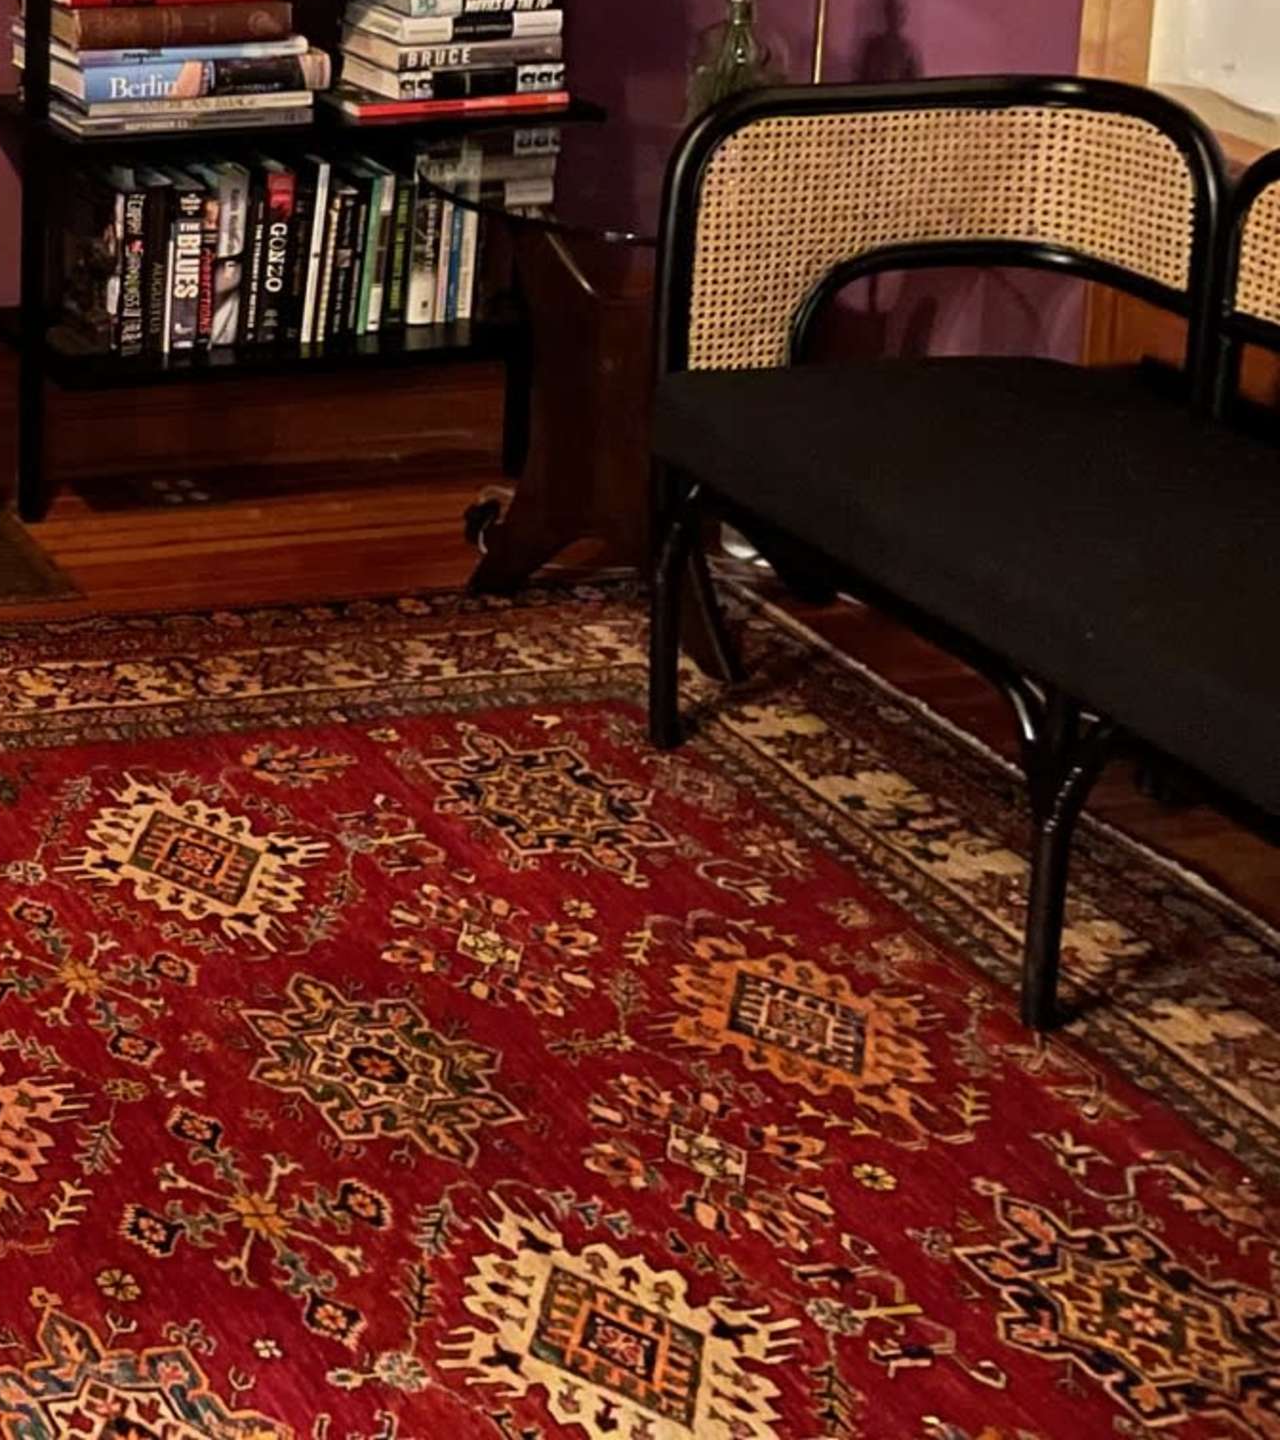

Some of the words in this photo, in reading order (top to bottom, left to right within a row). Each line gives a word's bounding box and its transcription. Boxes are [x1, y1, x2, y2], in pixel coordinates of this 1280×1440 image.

[406, 47, 472, 68] BRUCE
[109, 73, 178, 99] Berlin
[173, 234, 200, 299] BLUES
[265, 221, 288, 293] GONZO
